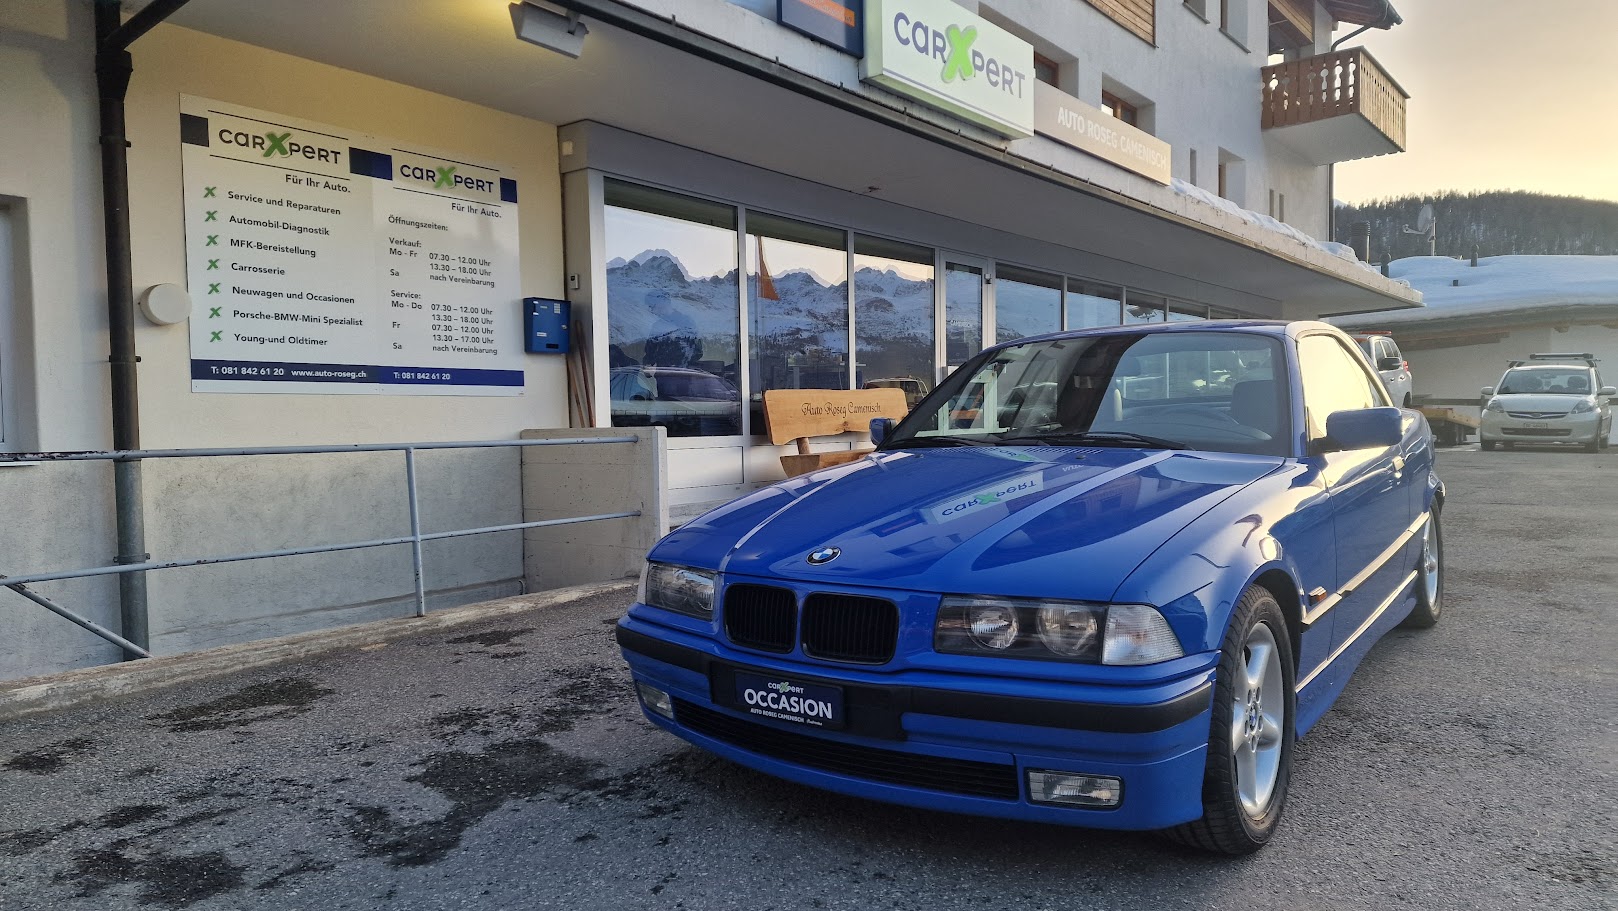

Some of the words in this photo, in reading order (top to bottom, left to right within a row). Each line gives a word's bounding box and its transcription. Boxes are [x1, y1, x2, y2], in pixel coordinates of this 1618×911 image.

[1058, 107, 1084, 133] AUTO
[1088, 120, 1118, 149] ROSEG
[1120, 136, 1167, 170] CAMENISCH
[285, 174, 302, 185] Für
[306, 178, 319, 188] Ihr
[323, 181, 351, 193] Auto.
[228, 191, 263, 203] Service
[266, 198, 283, 206] und
[286, 200, 341, 215] Reparaturen
[451, 203, 465, 212] Für
[467, 205, 478, 214] Ihr
[480, 208, 502, 218] Auto.
[229, 216, 330, 236] Automobil-Diagnostik
[388, 214, 448, 231] Öffnungszeiten:
[230, 238, 316, 258] MFK-Bereistellung
[388, 237, 422, 248] Verkauf:
[389, 248, 402, 256] Mo
[429, 252, 450, 261] 07.30
[458, 257, 476, 265] 12.00
[231, 262, 285, 275] Carrosserie
[430, 263, 450, 271] 13.30
[458, 267, 477, 275] 18.00
[430, 274, 446, 282] nach
[448, 275, 494, 288] Vereinbarung
[232, 286, 284, 299] Neuwagen
[286, 291, 303, 300] und
[306, 292, 355, 304] Occasionen
[390, 290, 421, 299] Service:
[412, 302, 422, 310] Do
[431, 304, 452, 312] 07.30
[460, 306, 478, 314] 12.00
[481, 307, 493, 315] Uhr
[233, 310, 321, 324] Porsche-BMW-Mini
[323, 316, 363, 326] Spezialist
[432, 314, 452, 322] 13.30
[460, 316, 479, 324] 18.00
[432, 324, 452, 332] 07.30
[234, 334, 285, 344] Young-und
[288, 336, 327, 346] Oldtimer
[461, 336, 479, 344] 17.00
[452, 345, 498, 355] Vereinbarung
[211, 366, 219, 374] T:
[221, 366, 238, 375] 081
[241, 367, 258, 375] 842
[273, 368, 284, 376] 20
[291, 369, 367, 379] www.auto-roseg.ch
[801, 403, 822, 415] Auto
[824, 402, 846, 418] Roseg
[848, 402, 881, 413] Camenisch
[744, 689, 832, 719] OCCASION
[763, 709, 777, 718] ROSEG
[778, 713, 804, 723] CAMENISCH
